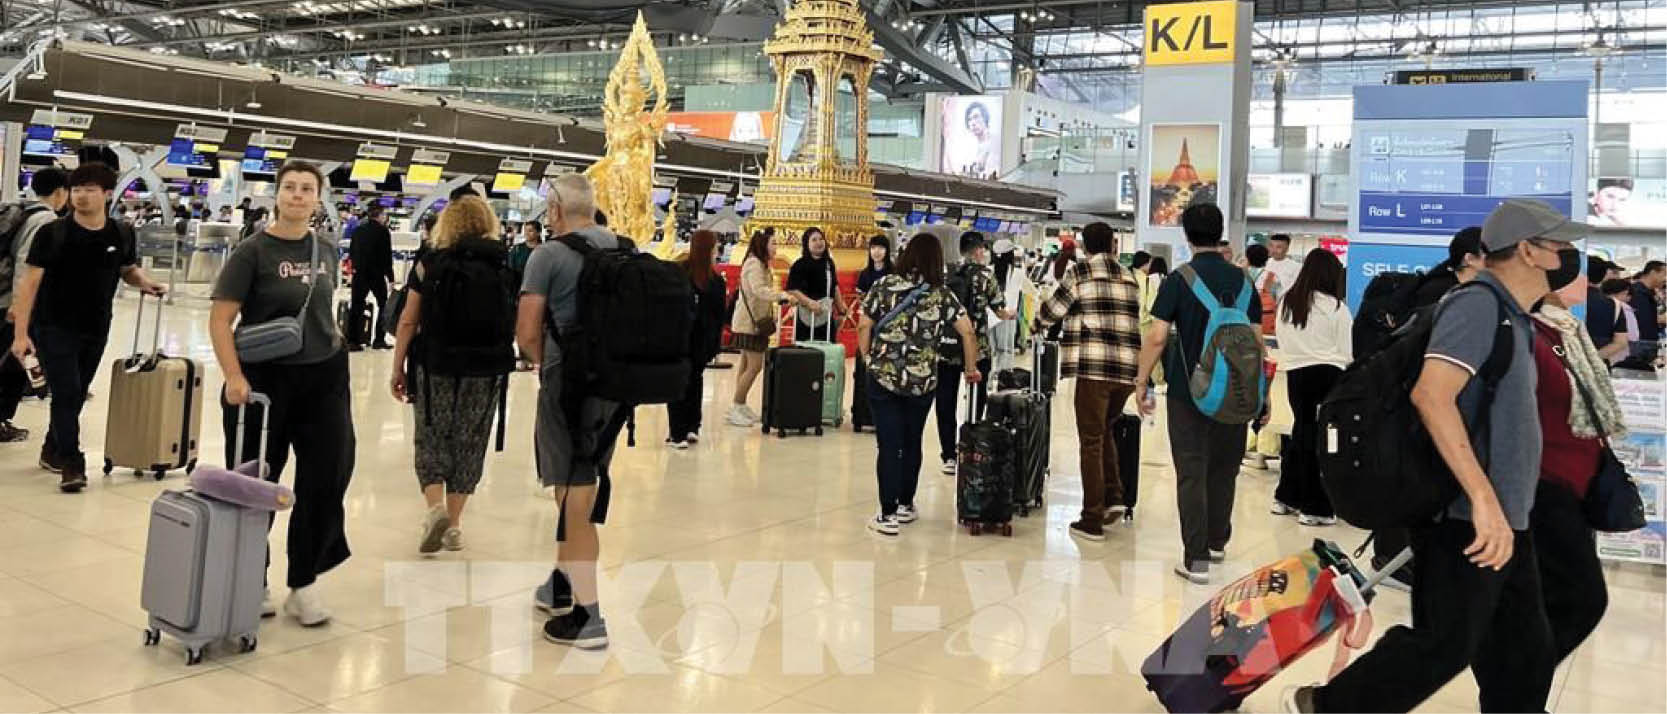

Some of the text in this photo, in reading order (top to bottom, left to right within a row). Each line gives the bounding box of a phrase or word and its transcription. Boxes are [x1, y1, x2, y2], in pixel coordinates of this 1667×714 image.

[1151, 14, 1228, 52] K/L
[1451, 71, 1512, 82] International
[1396, 169, 1407, 184] K
[1368, 203, 1407, 217] Row L
